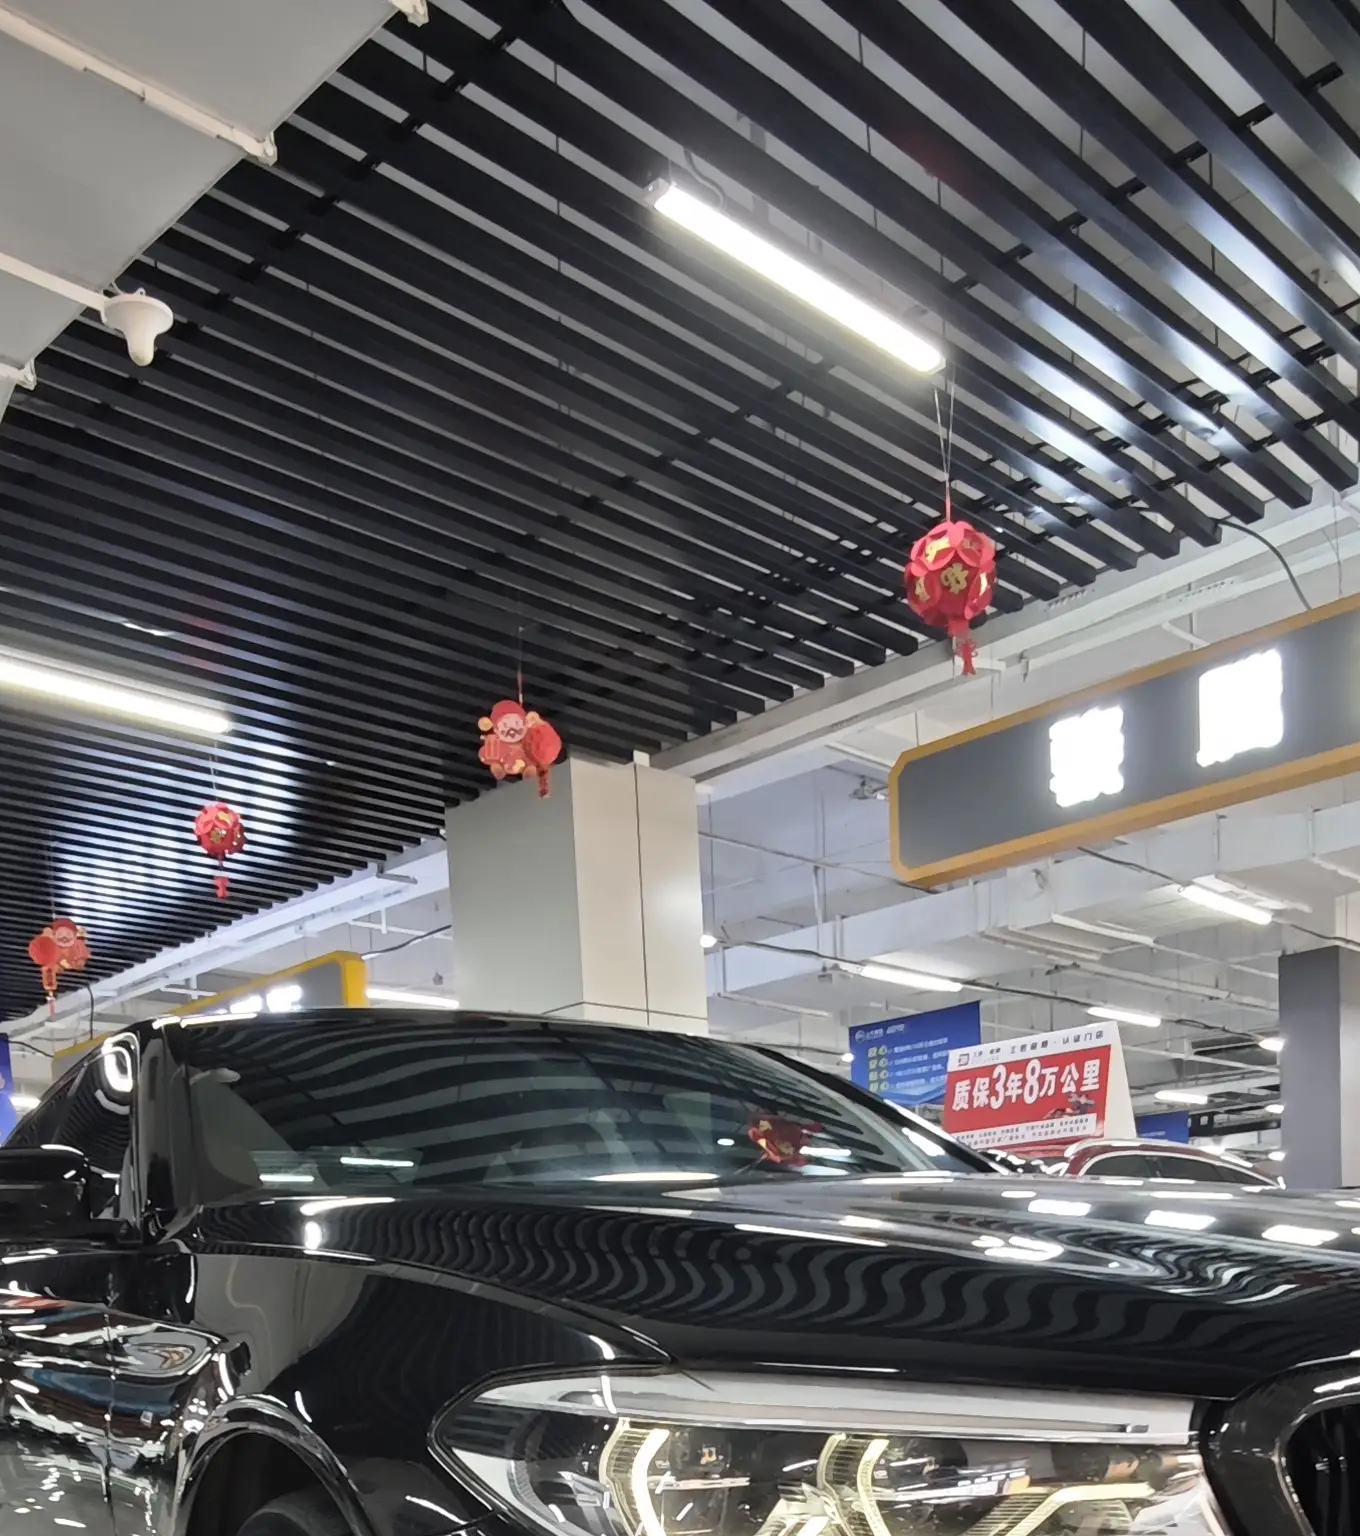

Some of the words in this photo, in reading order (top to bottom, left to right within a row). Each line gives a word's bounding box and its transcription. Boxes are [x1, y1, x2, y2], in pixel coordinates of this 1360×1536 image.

[952, 1059, 1100, 1111] 质保3年8万公里
